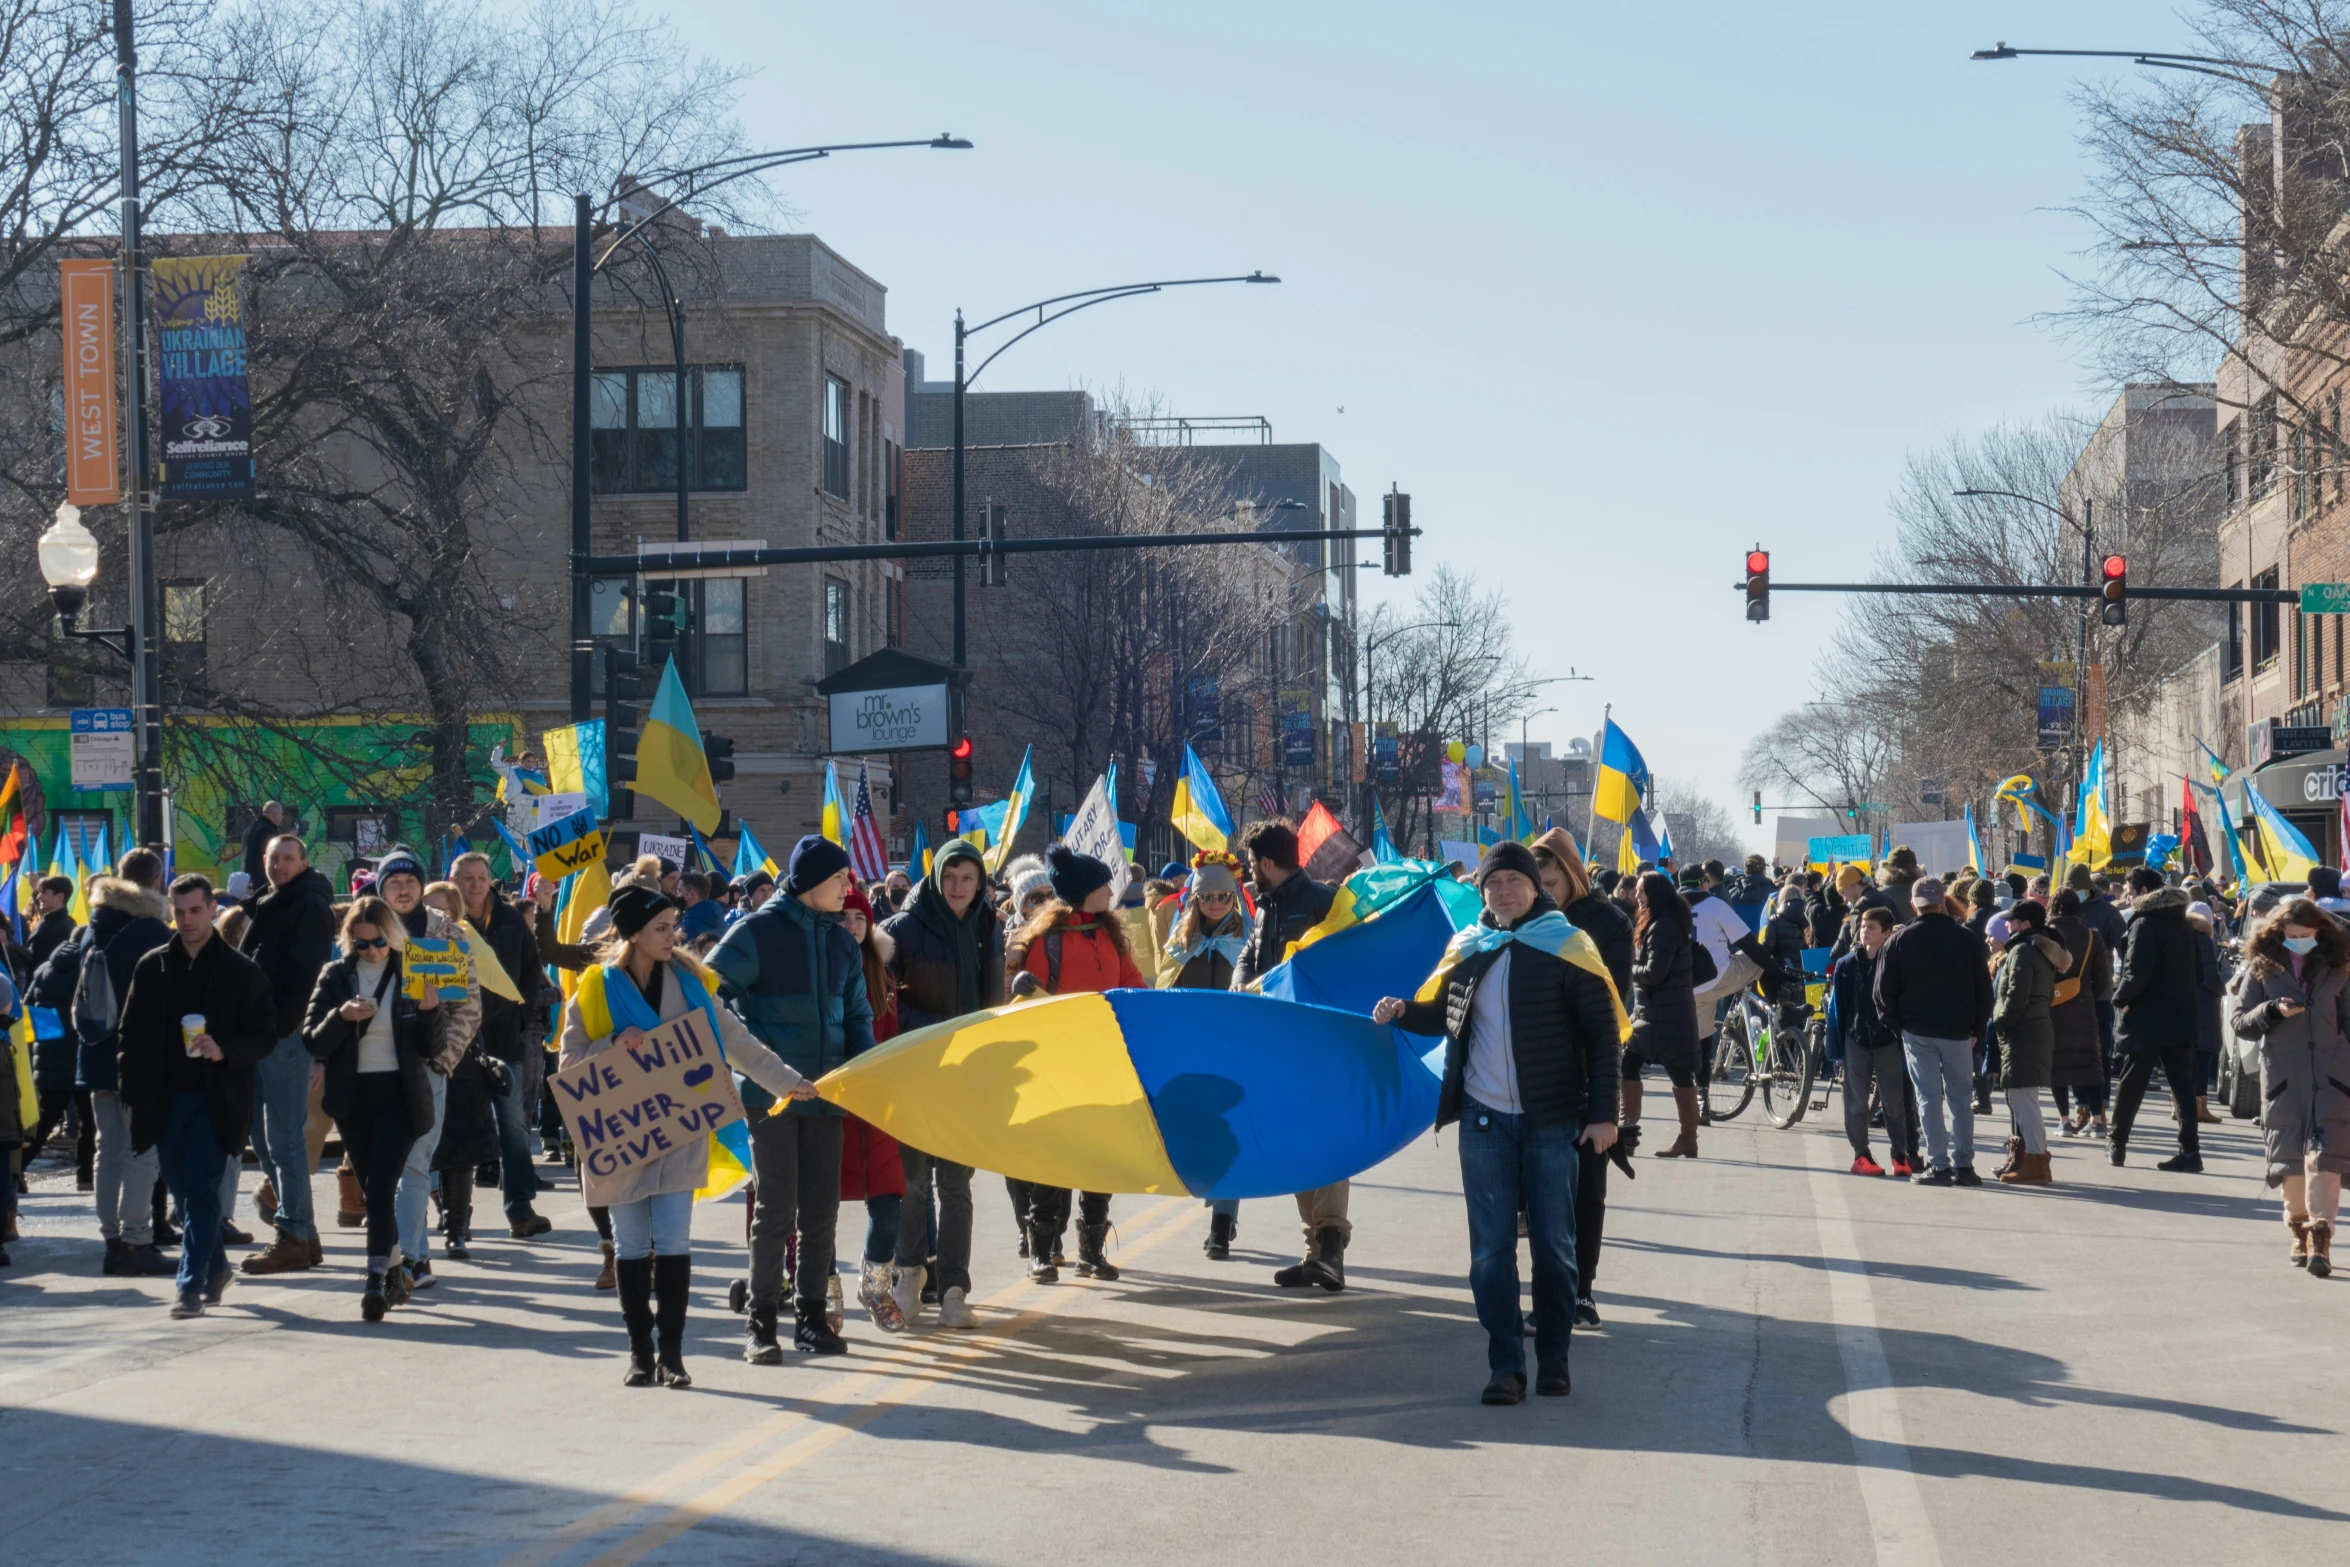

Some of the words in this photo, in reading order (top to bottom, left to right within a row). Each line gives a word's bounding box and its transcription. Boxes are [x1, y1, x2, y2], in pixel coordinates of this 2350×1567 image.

[78, 304, 100, 379] TOWN
[161, 327, 246, 352] UKRAINIAN
[162, 349, 248, 379] VILLAGE
[81, 389, 103, 460] WEST
[166, 440, 249, 454] Selfreliance
[184, 461, 214, 471] SERVING
[215, 461, 230, 470] OUR
[184, 469, 232, 479] COMMUNITY
[2307, 588, 2315, 597] N
[2040, 695, 2074, 708] VILLAGE
[110, 712, 126, 721] bus
[856, 702, 921, 729] brown's
[110, 720, 130, 731] stop
[872, 725, 917, 742] lounge
[2275, 730, 2298, 739] OREST
[2283, 739, 2322, 749] LAWYER
[1071, 801, 1099, 853] LITARY
[531, 825, 562, 857] NO
[643, 840, 685, 858] UKRAINE
[1810, 836, 1841, 856] STOP
[553, 841, 600, 869] War
[405, 941, 435, 962] Russian
[404, 975, 416, 991] go
[577, 1093, 686, 1150] NEVER
[678, 1102, 726, 1133] UP
